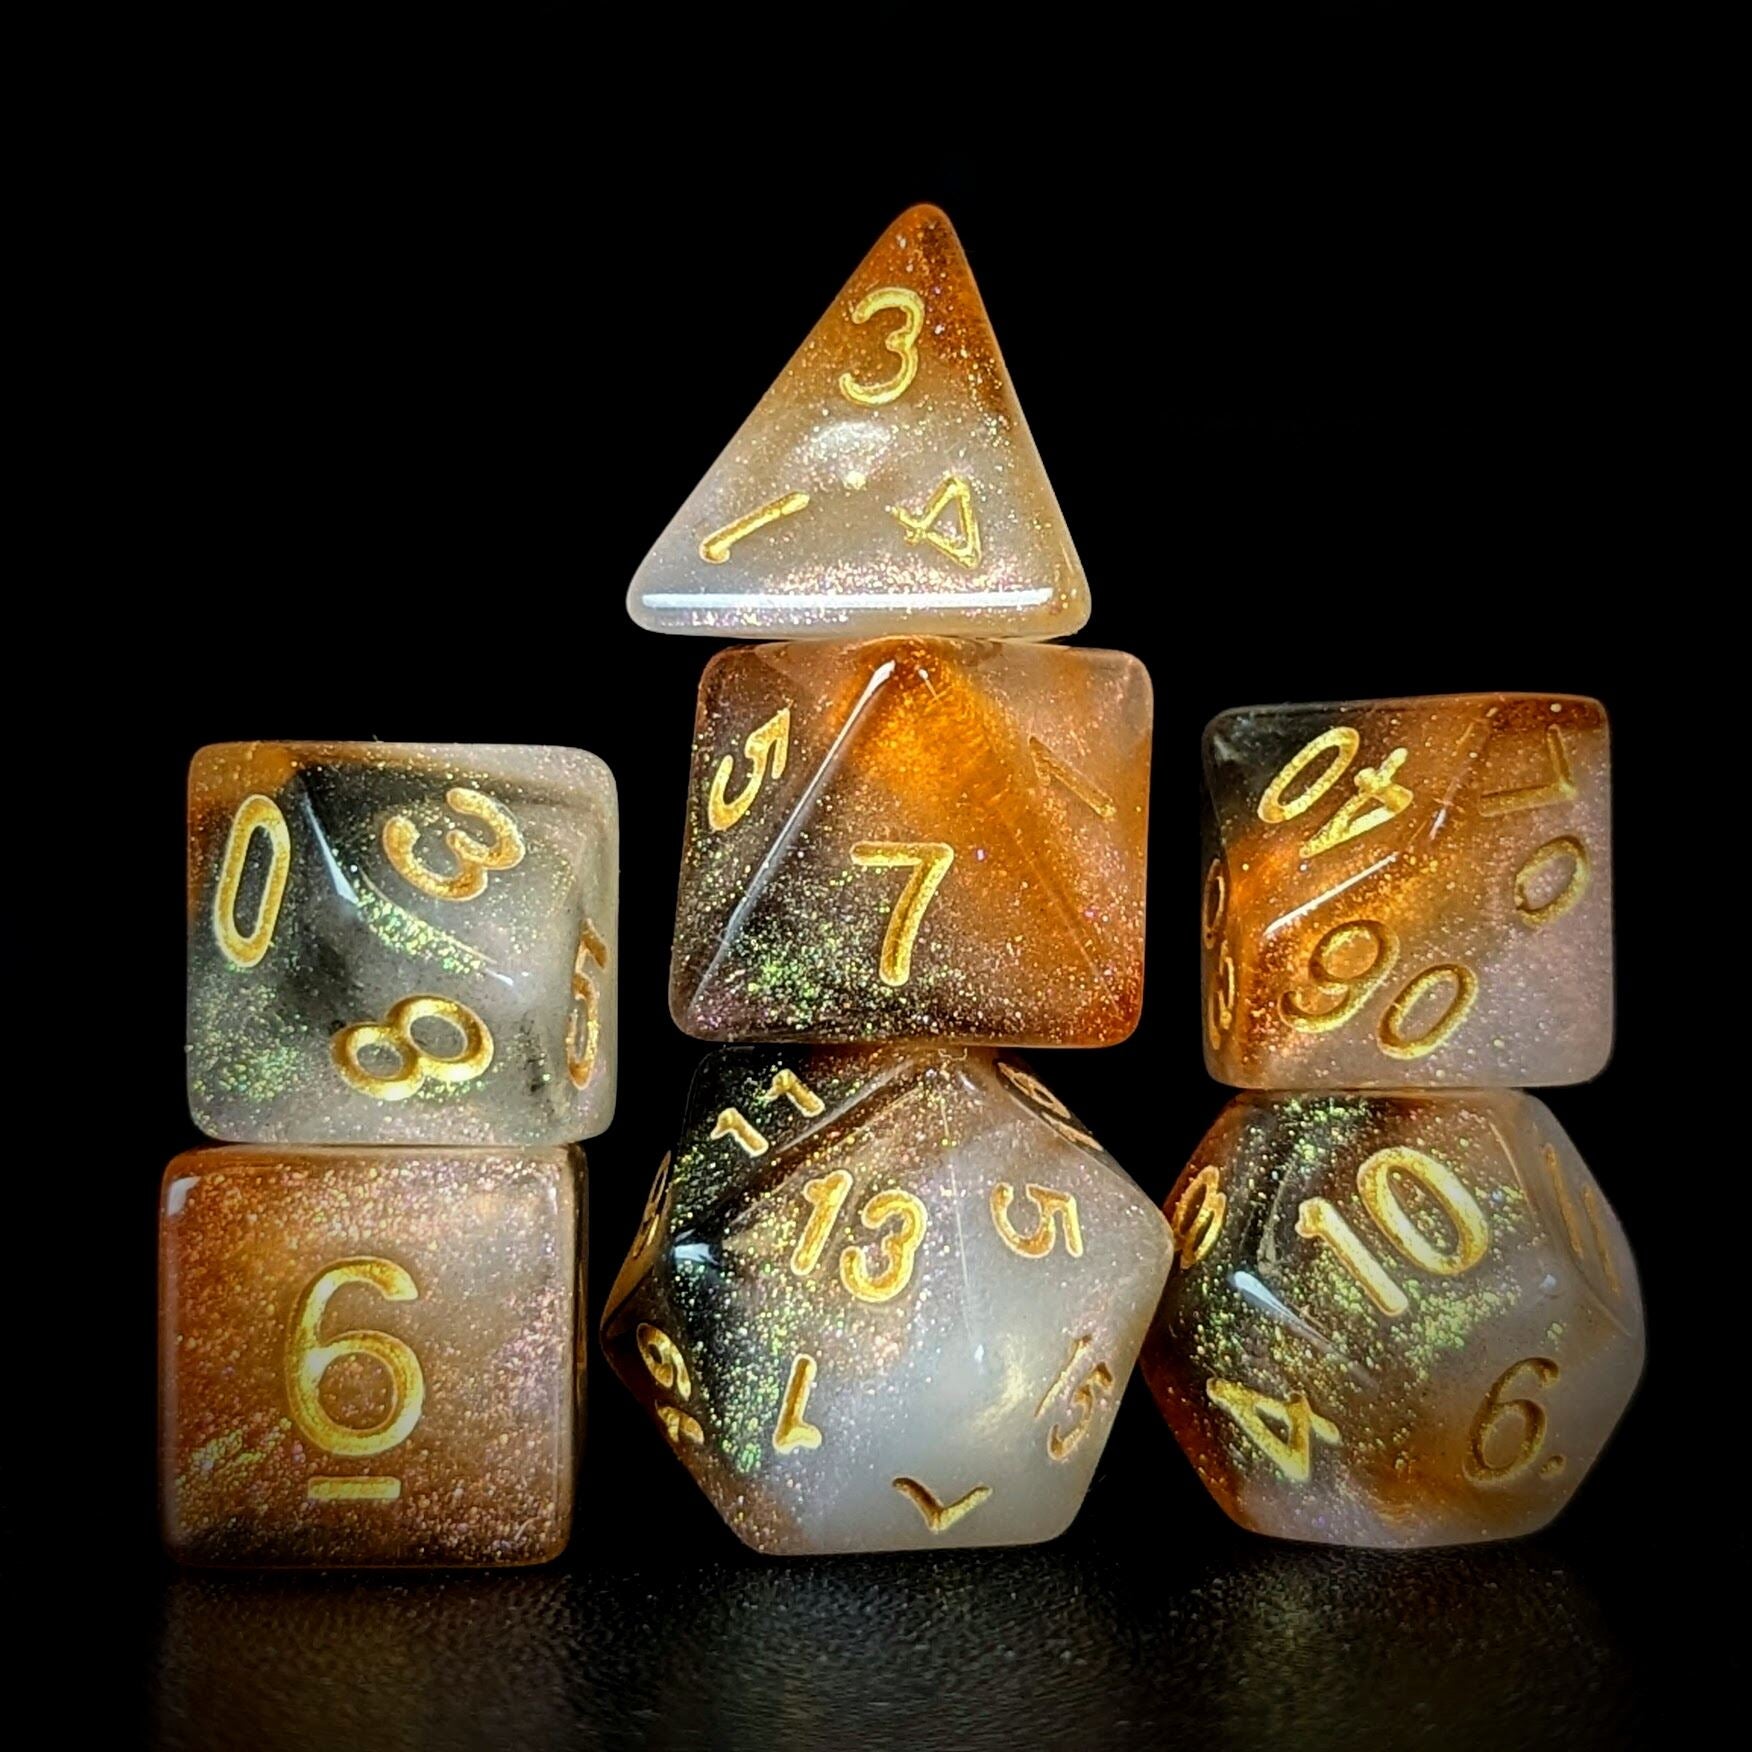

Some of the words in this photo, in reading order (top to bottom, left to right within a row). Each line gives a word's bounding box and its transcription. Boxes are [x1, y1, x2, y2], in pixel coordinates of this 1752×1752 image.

[839, 286, 925, 406] 3
[699, 491, 811, 565] 1
[886, 473, 981, 570] 4
[708, 706, 790, 831] 5
[1029, 736, 1116, 819] 1
[214, 794, 290, 967] 0
[383, 787, 526, 902] 3
[850, 841, 954, 987] 7
[331, 994, 494, 1101] 8
[1278, 920, 1478, 1060] 90
[790, 1170, 927, 1302] 13
[990, 1183, 1073, 1258] 5
[1296, 1146, 1489, 1318] 10
[772, 1353, 822, 1453] 1
[1207, 1376, 1343, 1483] 4
